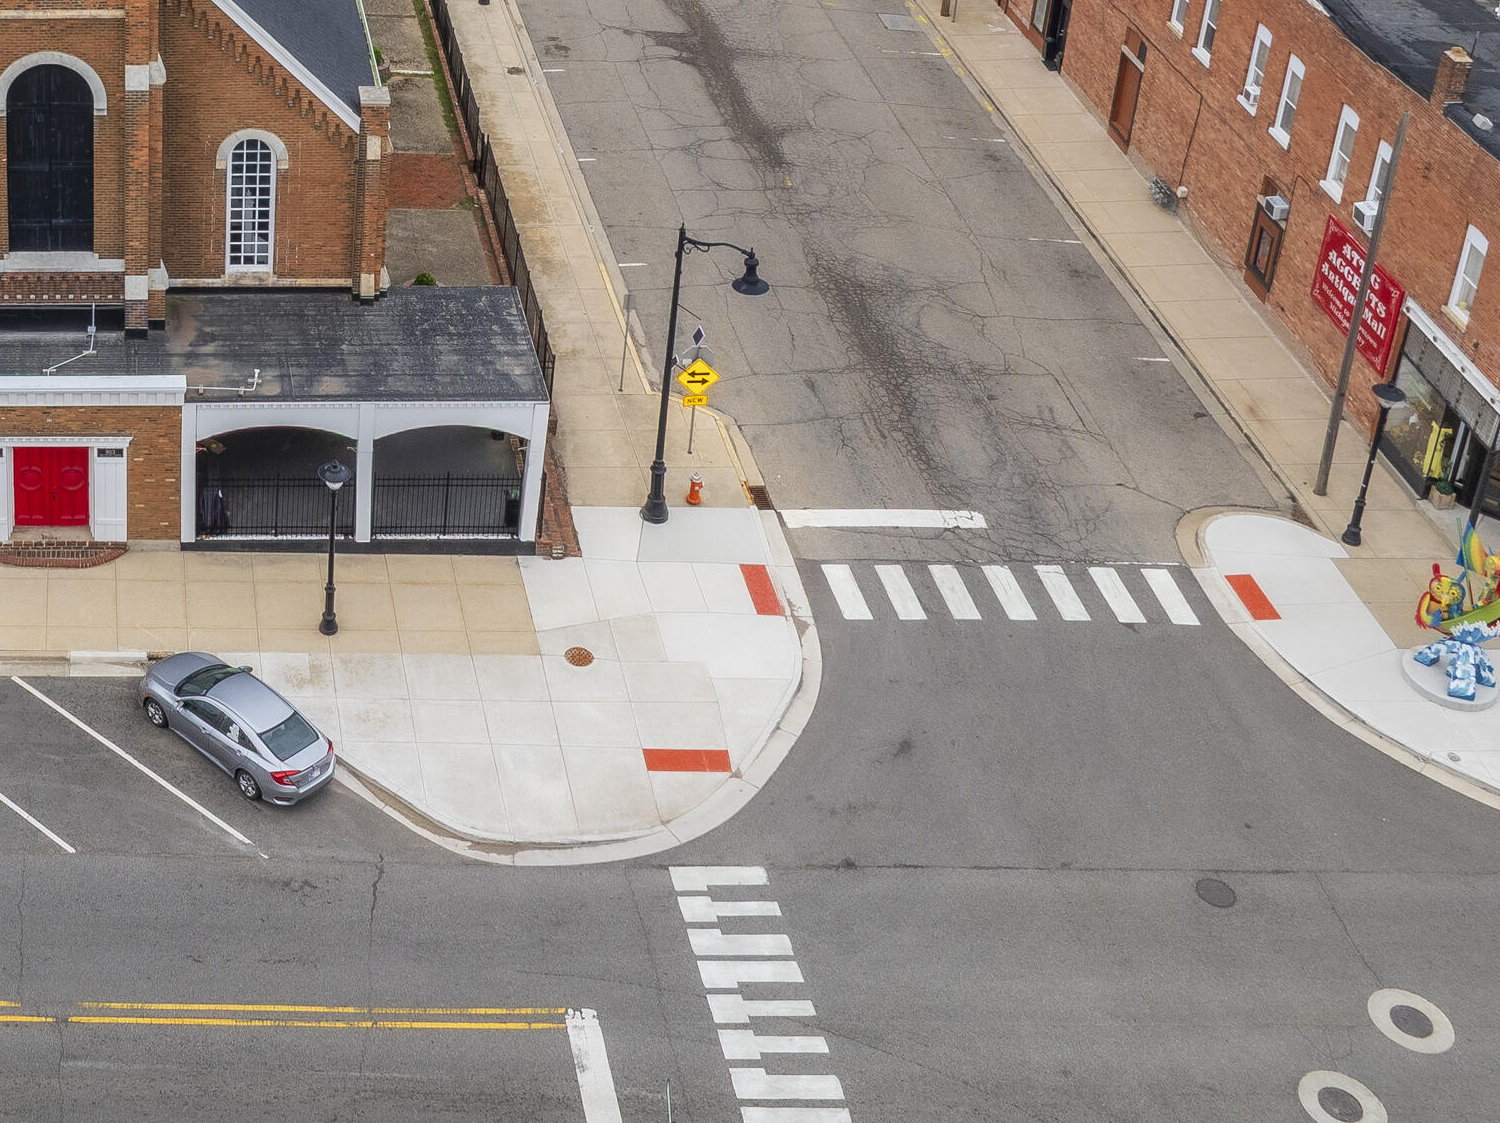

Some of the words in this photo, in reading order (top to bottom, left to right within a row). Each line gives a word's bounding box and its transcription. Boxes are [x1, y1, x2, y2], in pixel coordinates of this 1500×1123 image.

[1329, 302, 1350, 329] Michiga
[1343, 308, 1350, 317] to
[1361, 306, 1387, 341] Mall
